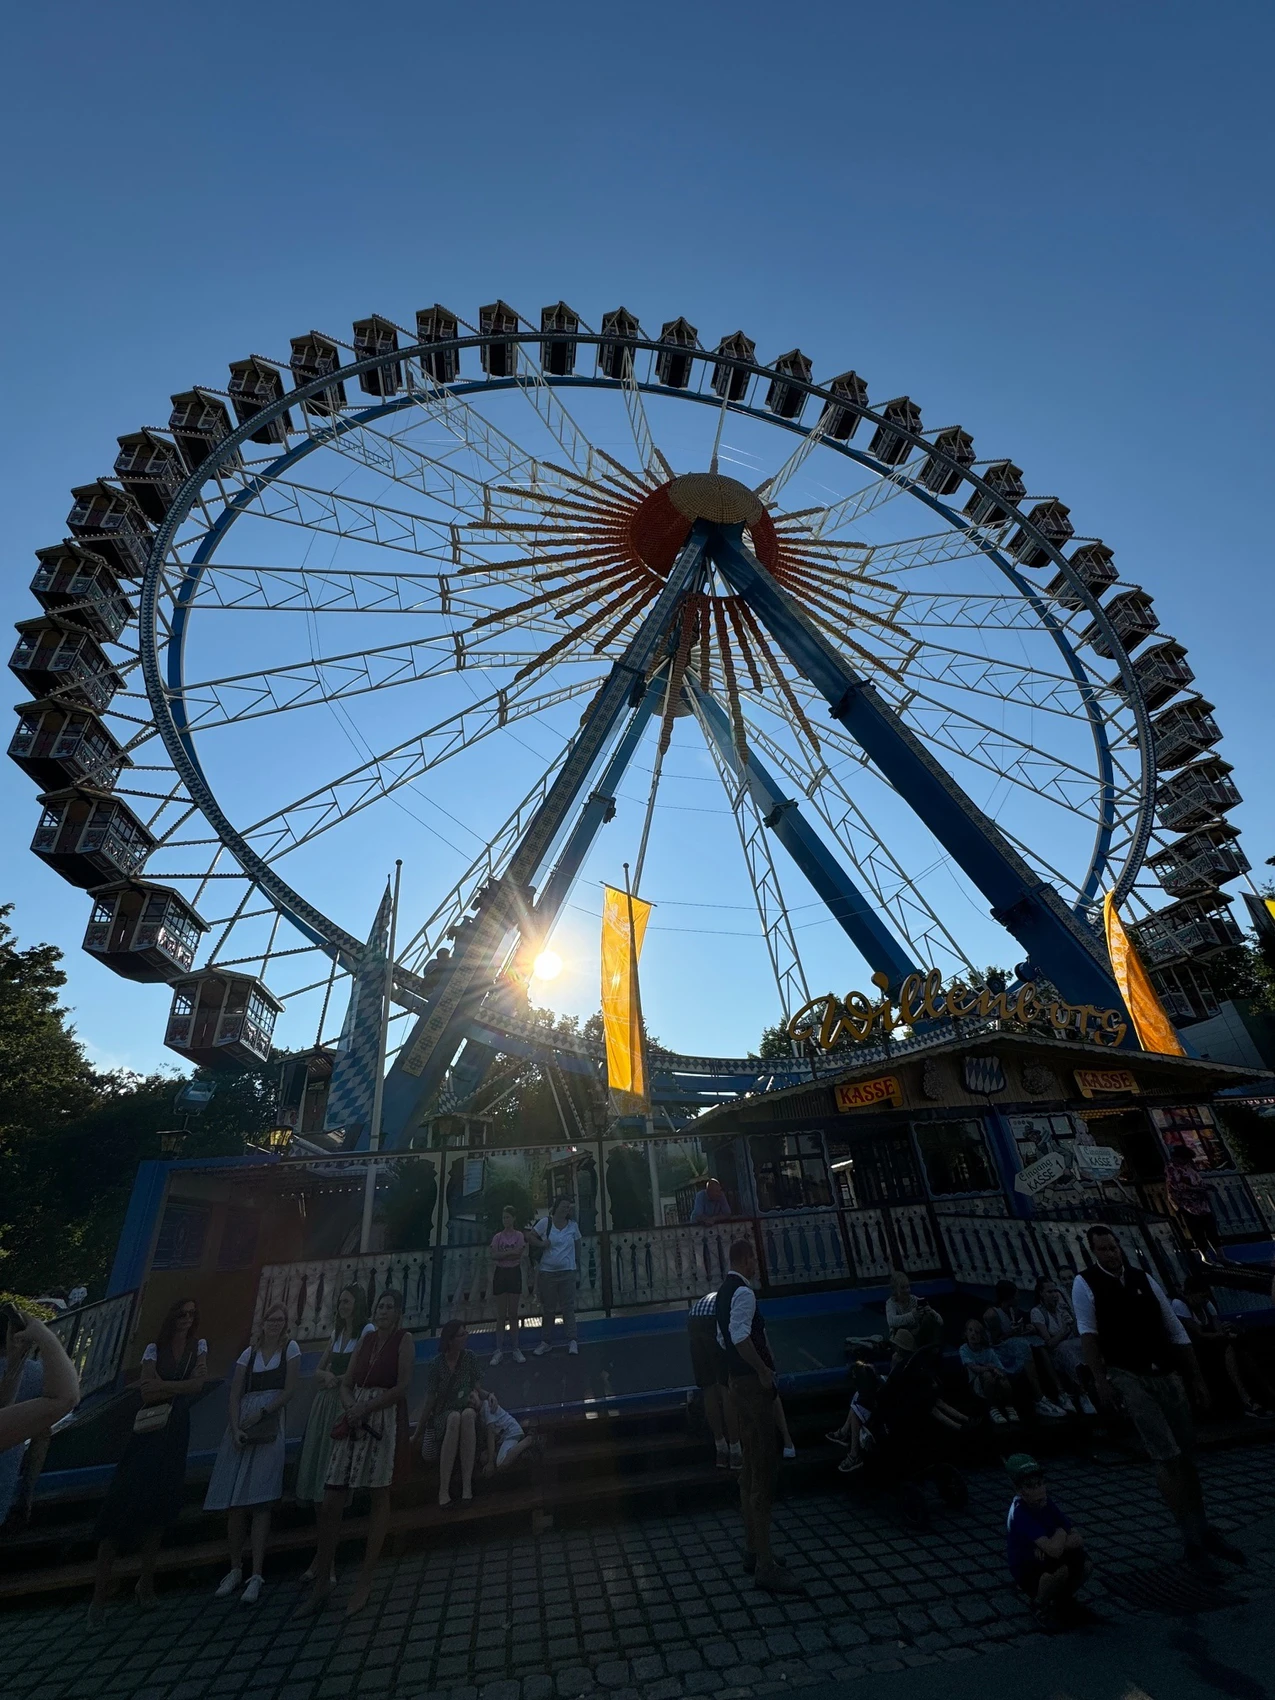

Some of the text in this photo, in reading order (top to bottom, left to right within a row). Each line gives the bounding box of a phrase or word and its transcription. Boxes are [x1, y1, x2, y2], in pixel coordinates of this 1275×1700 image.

[787, 967, 1128, 1050] Willenborg
[839, 1078, 895, 1105] KASSE
[1077, 1071, 1133, 1089] KASSE
[1018, 1159, 1054, 1182] Eingang
[1113, 1155, 1121, 1166] 2
[1026, 1159, 1064, 1192] KASSE 1
